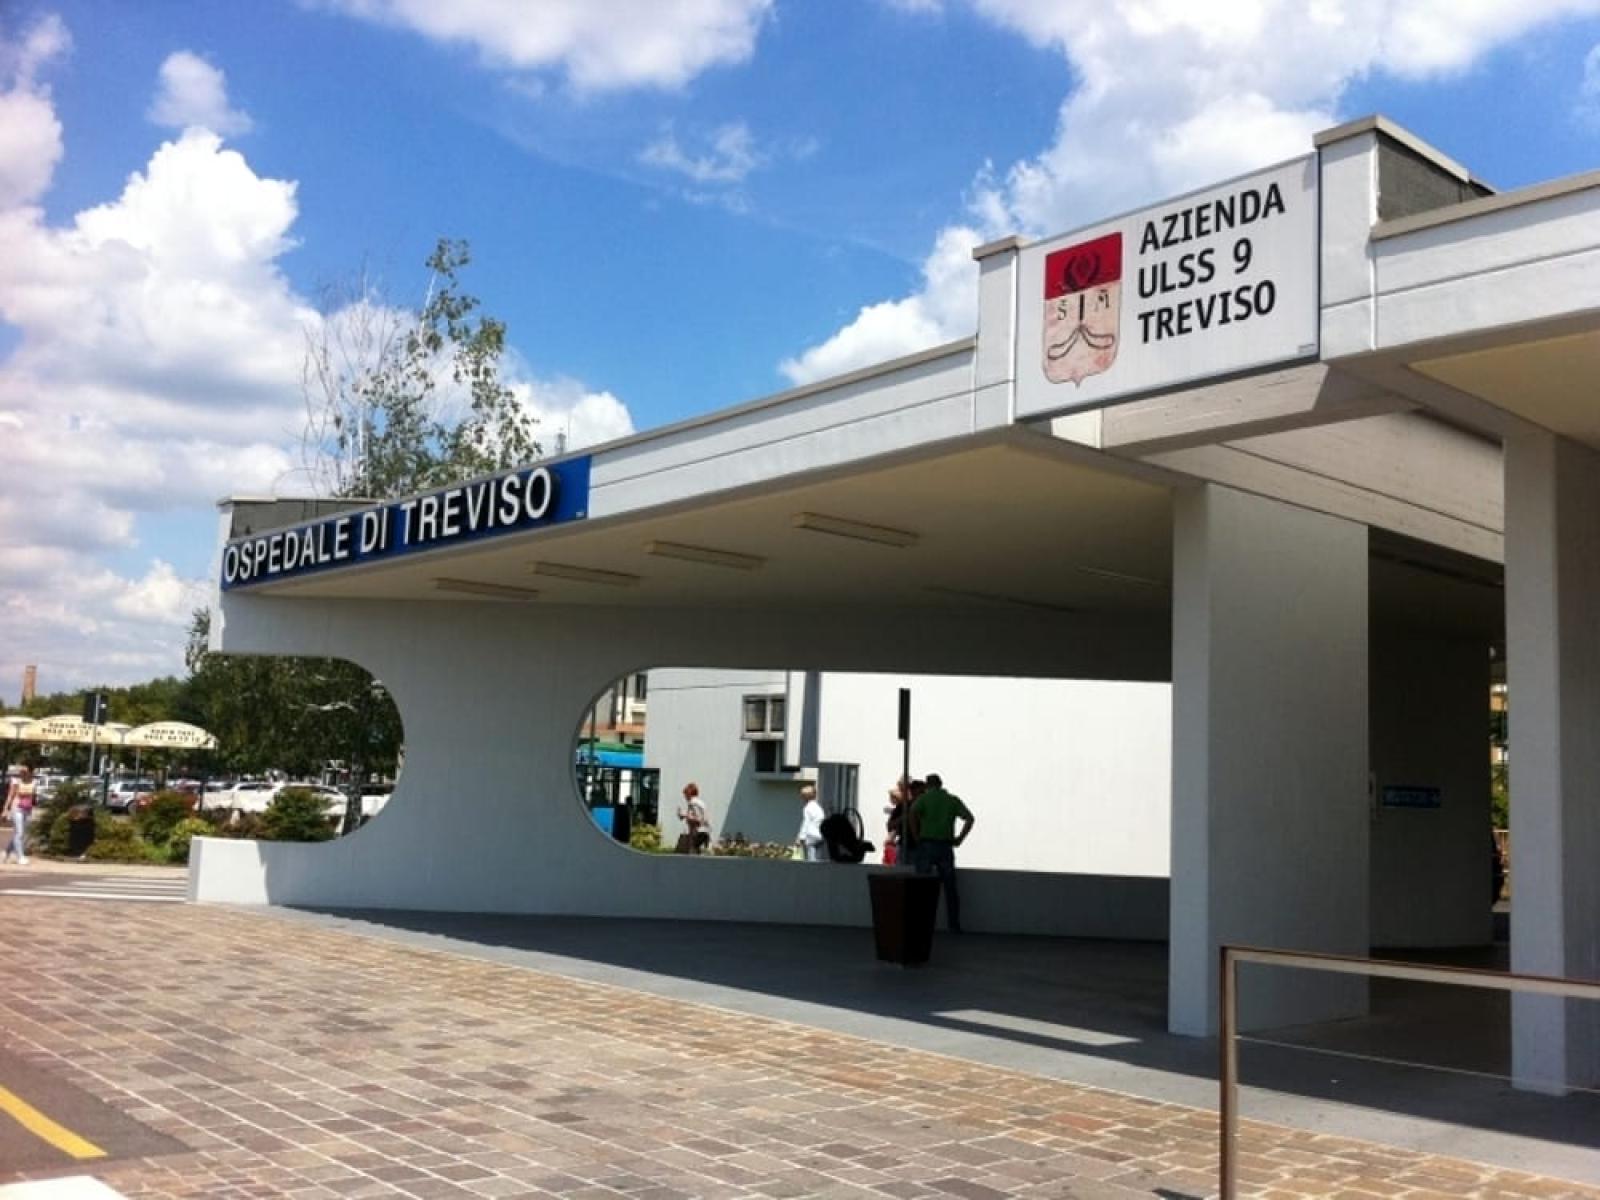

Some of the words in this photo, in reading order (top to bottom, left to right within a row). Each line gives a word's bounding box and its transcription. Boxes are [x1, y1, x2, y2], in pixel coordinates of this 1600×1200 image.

[1140, 183, 1285, 254] AZIENDA
[1138, 248, 1215, 299] ULSS
[1234, 238, 1252, 275] 9
[1138, 280, 1275, 344] TREVISO
[223, 518, 350, 583] OSPEDALE
[361, 509, 388, 554] DI
[400, 467, 553, 545] TREVISO
